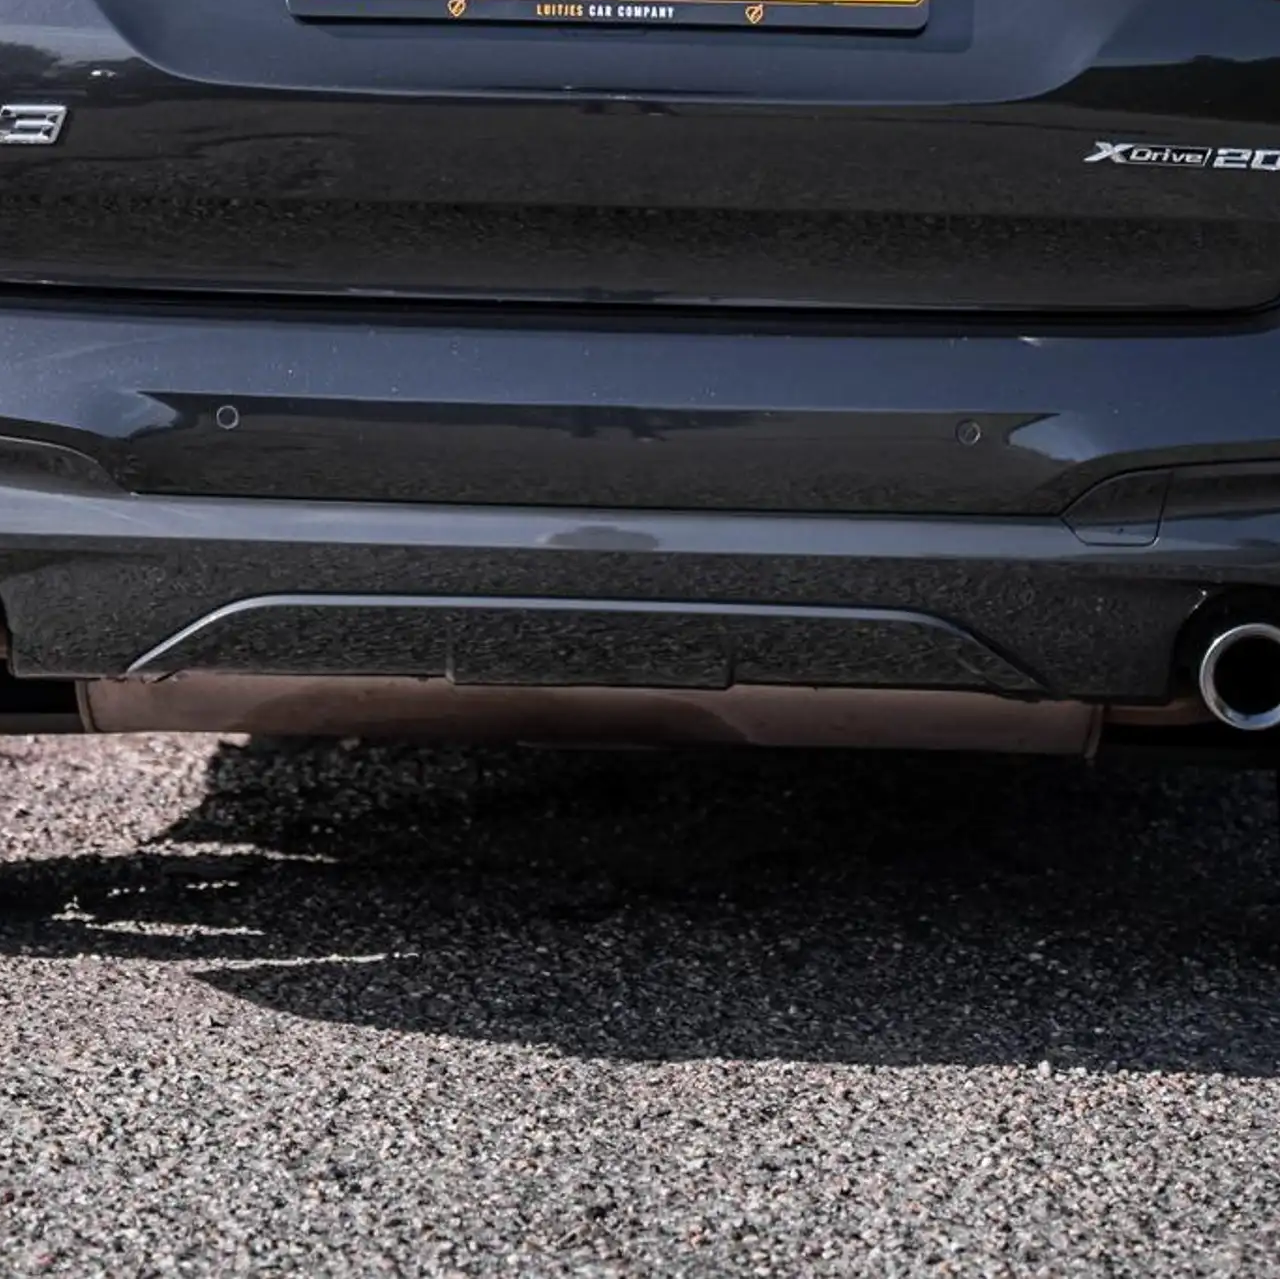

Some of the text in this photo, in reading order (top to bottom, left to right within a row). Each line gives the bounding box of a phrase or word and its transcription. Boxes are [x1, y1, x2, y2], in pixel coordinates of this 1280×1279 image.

[536, 3, 675, 19] LUITJES CAR COMPANY
